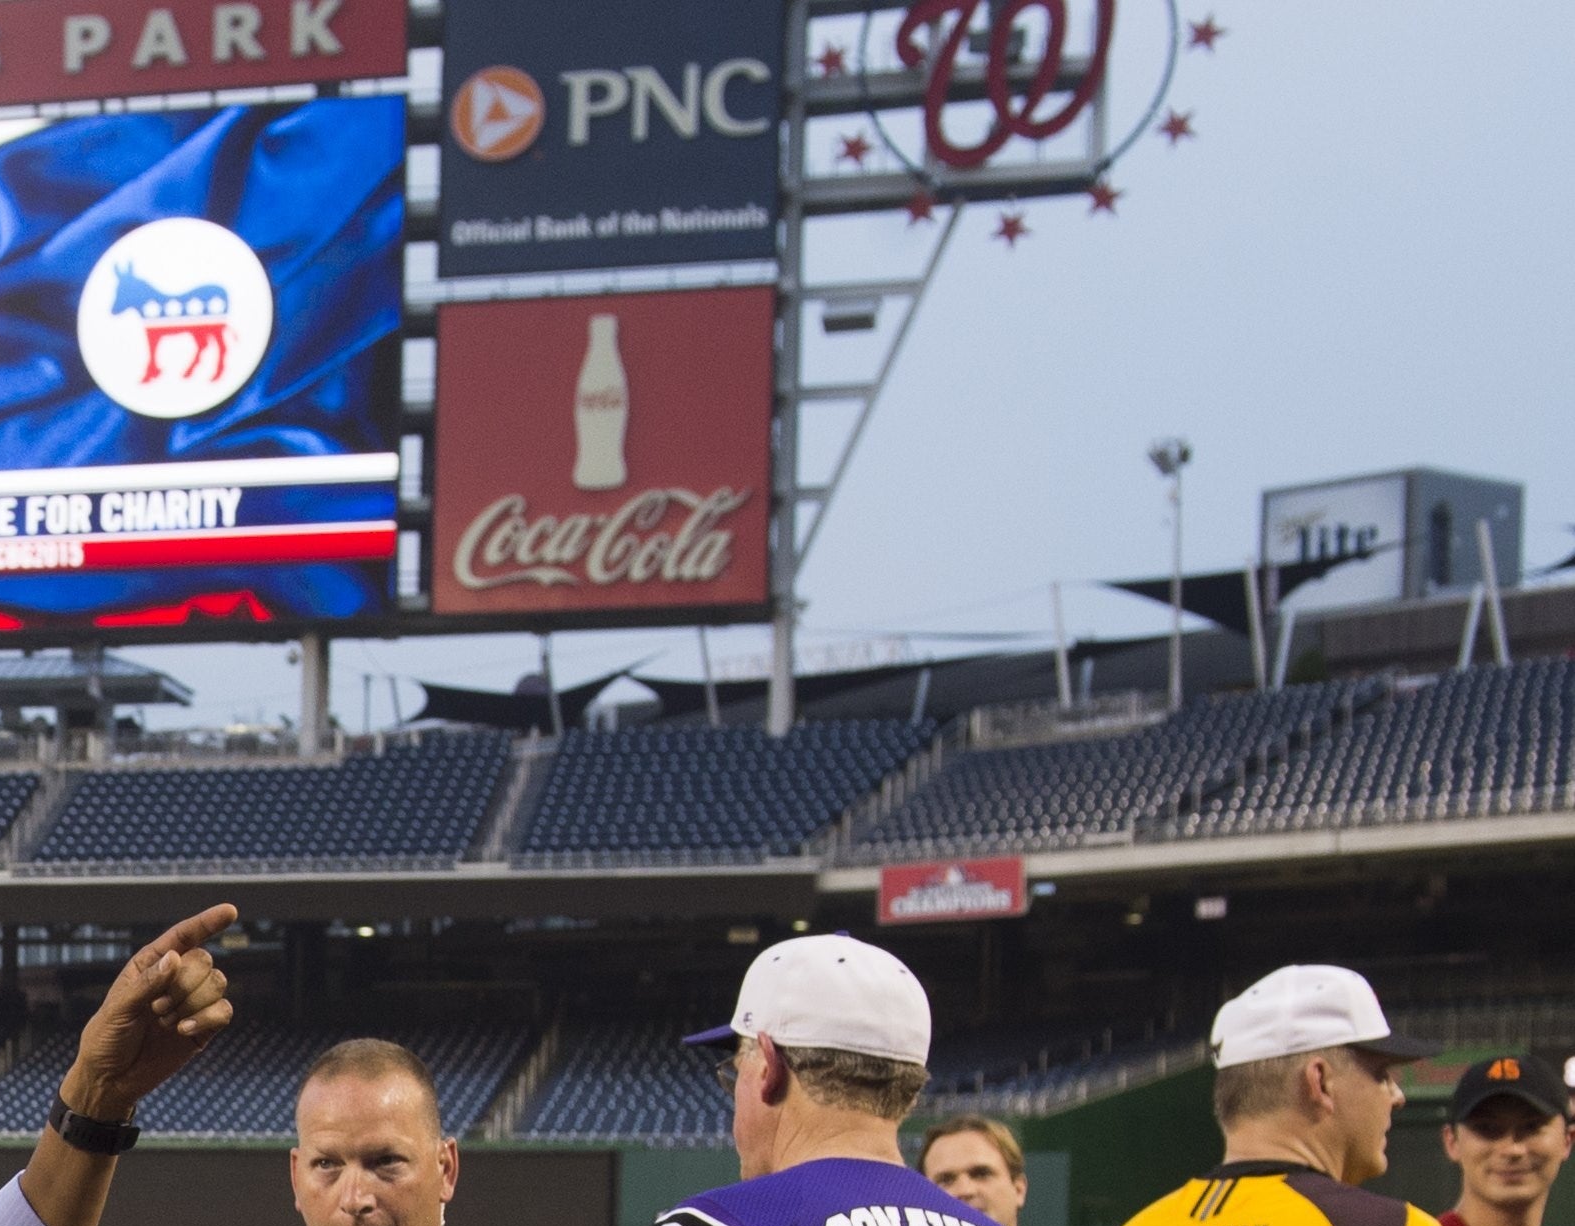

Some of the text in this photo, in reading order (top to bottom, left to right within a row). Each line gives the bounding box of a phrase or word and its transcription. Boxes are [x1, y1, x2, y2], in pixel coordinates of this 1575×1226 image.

[63, 0, 342, 73] PARK
[559, 57, 771, 147] PNC
[450, 202, 770, 246] Official Bank of the Nationals
[25, 494, 92, 536] FOR
[99, 487, 243, 534] CHARITY
[454, 487, 752, 591] Coca-Cola
